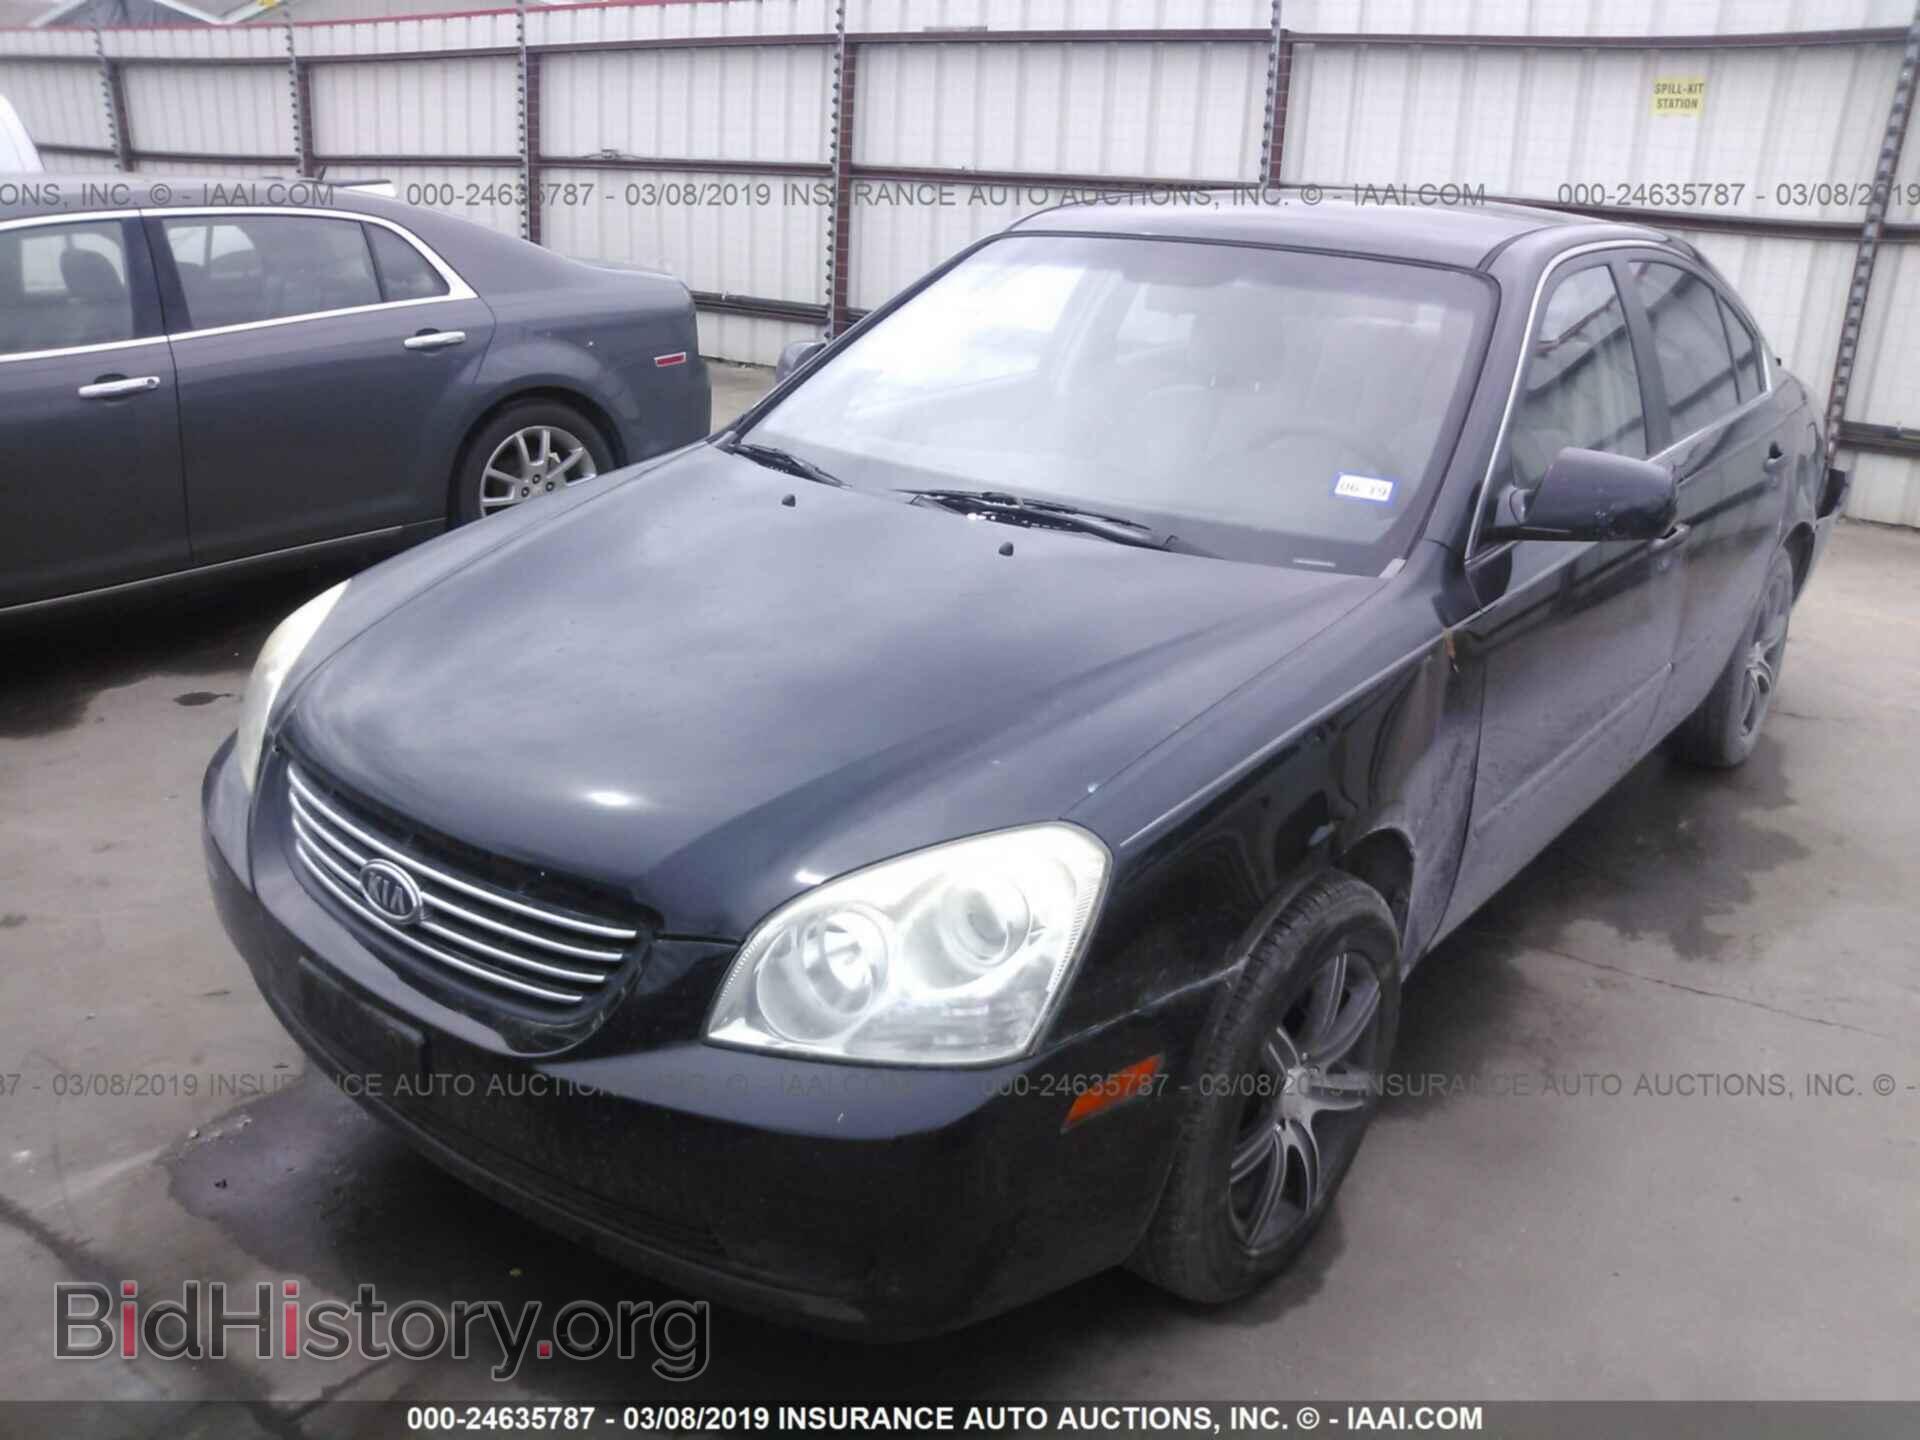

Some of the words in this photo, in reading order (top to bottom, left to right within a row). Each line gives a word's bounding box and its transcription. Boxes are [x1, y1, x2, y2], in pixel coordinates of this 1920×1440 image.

[1654, 82, 1704, 95] SPILL-KIT
[1657, 97, 1699, 110] STATION
[367, 871, 406, 914] KIA
